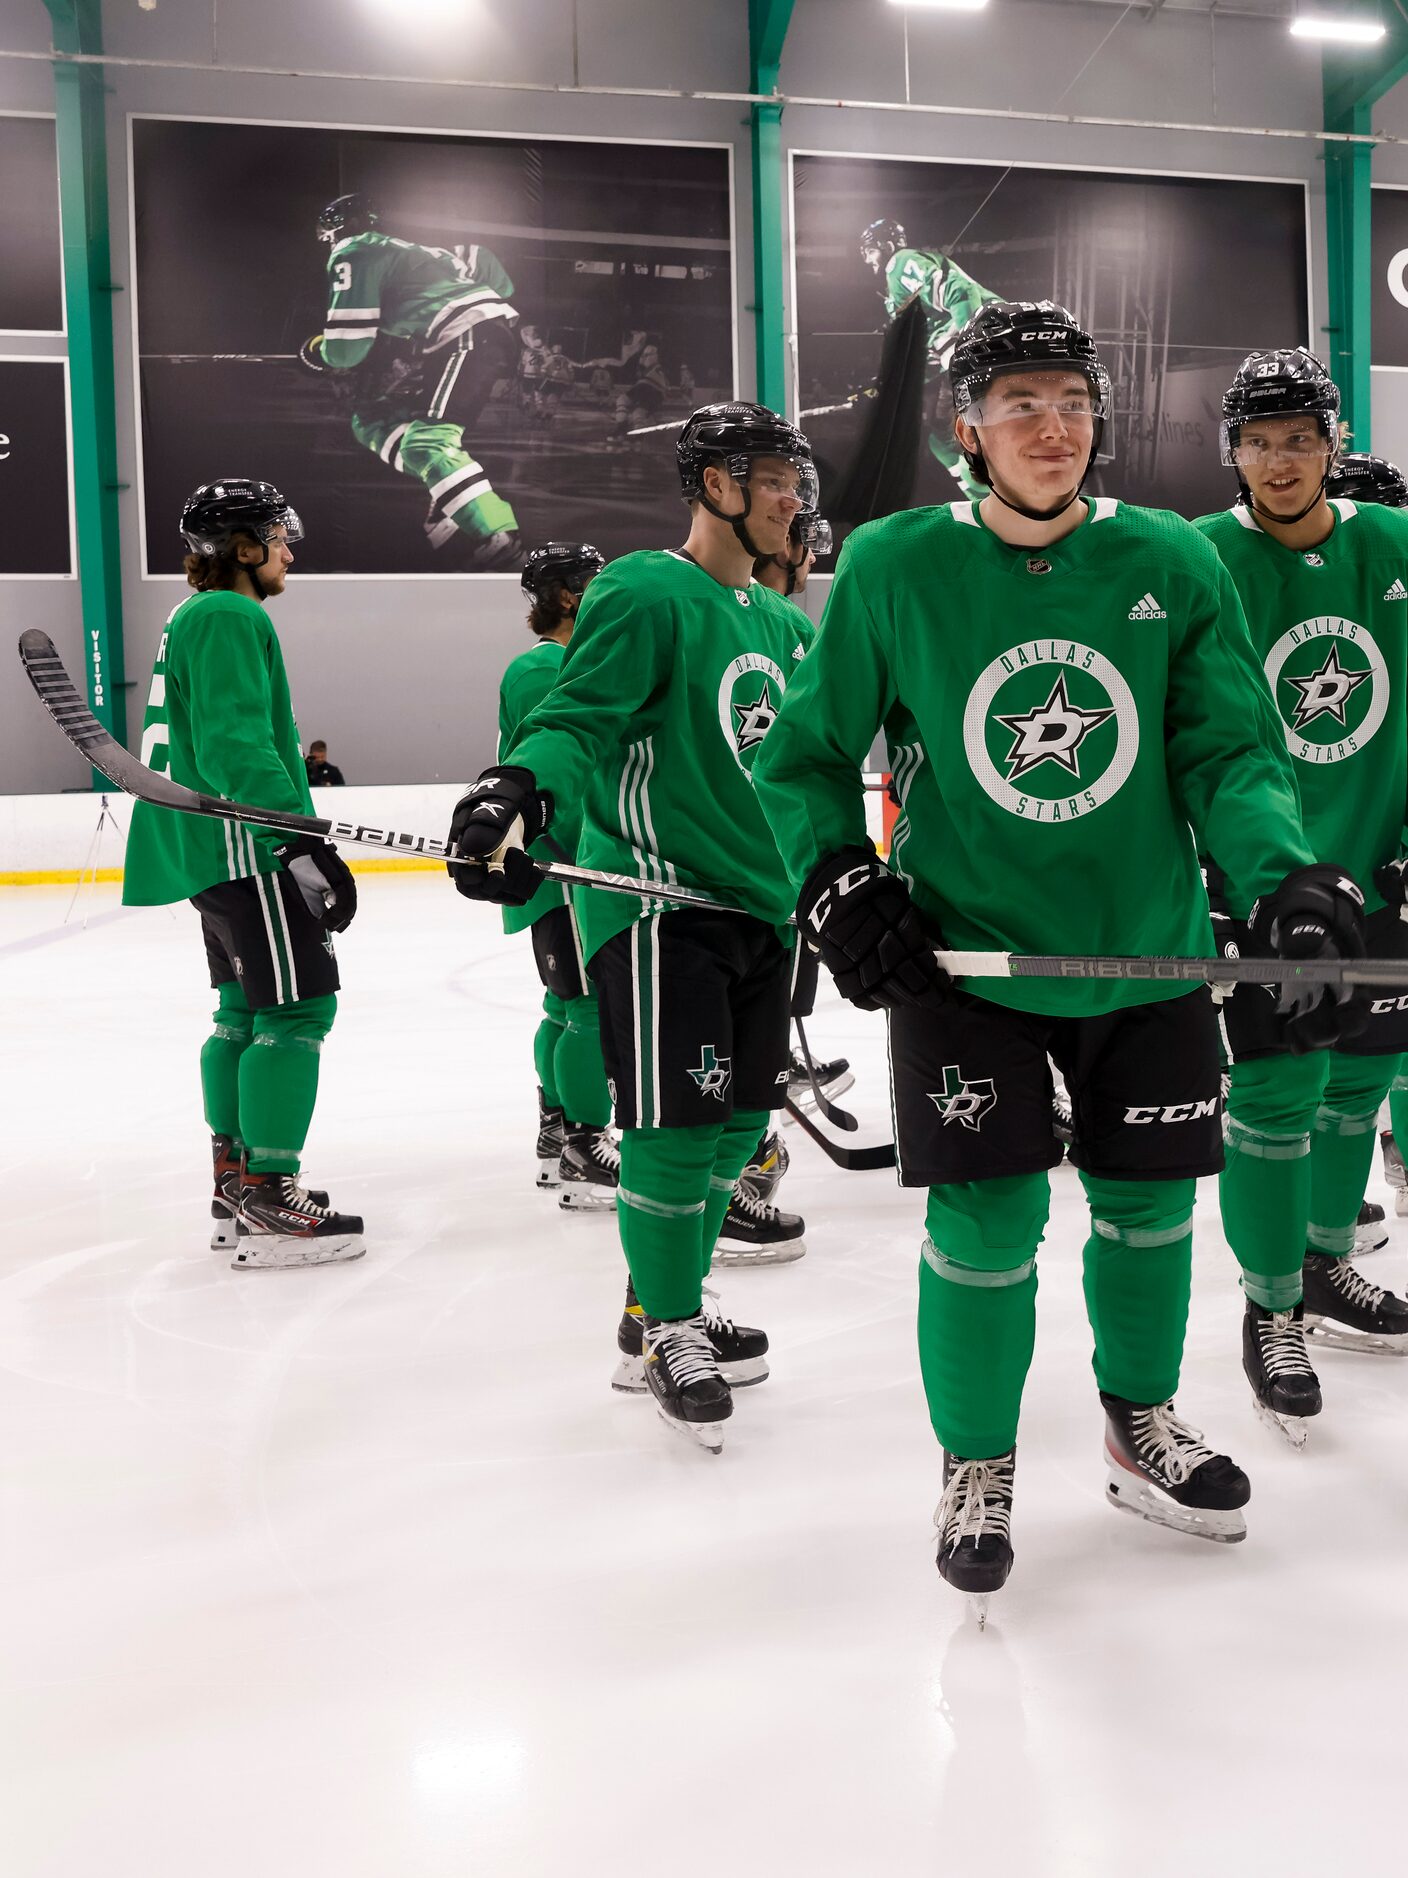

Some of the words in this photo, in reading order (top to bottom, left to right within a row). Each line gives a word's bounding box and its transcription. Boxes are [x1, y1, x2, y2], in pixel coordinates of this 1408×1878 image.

[1021, 331, 1067, 342] CCM
[1257, 363, 1280, 378] 33
[1383, 591, 1408, 601] adida
[1128, 609, 1167, 620] adidas
[1289, 618, 1357, 645] DALLAS
[91, 630, 104, 706] VISITOR
[735, 656, 781, 681] DALLAS
[1000, 641, 1096, 674] DALLAS
[1300, 737, 1358, 762] STARS
[1016, 791, 1097, 821] STARS
[1123, 1097, 1218, 1124] CCM
[278, 1211, 311, 1226] CCM
[1136, 1459, 1175, 1489] CCM
